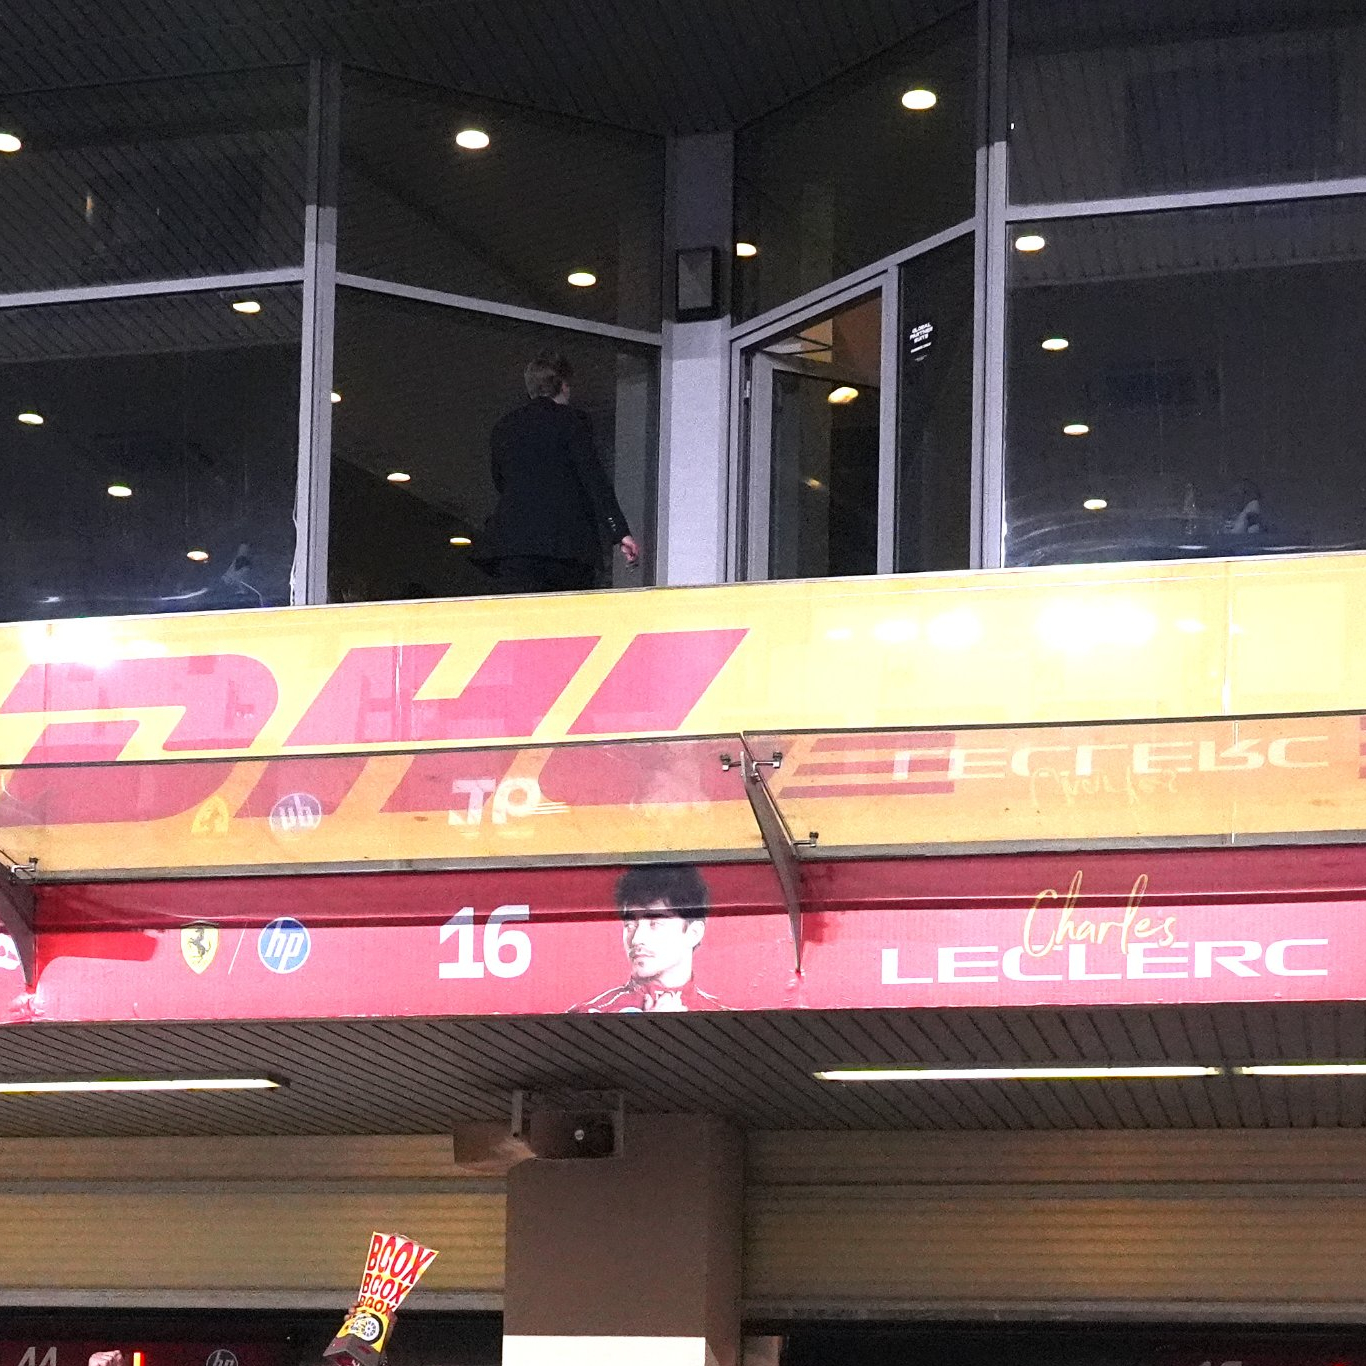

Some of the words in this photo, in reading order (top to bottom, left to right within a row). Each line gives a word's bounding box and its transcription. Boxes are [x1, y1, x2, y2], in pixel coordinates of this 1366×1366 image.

[262, 917, 307, 973] hp
[438, 905, 532, 980] 16
[1023, 870, 1177, 957] Charles
[881, 937, 1330, 985] LECLERC
